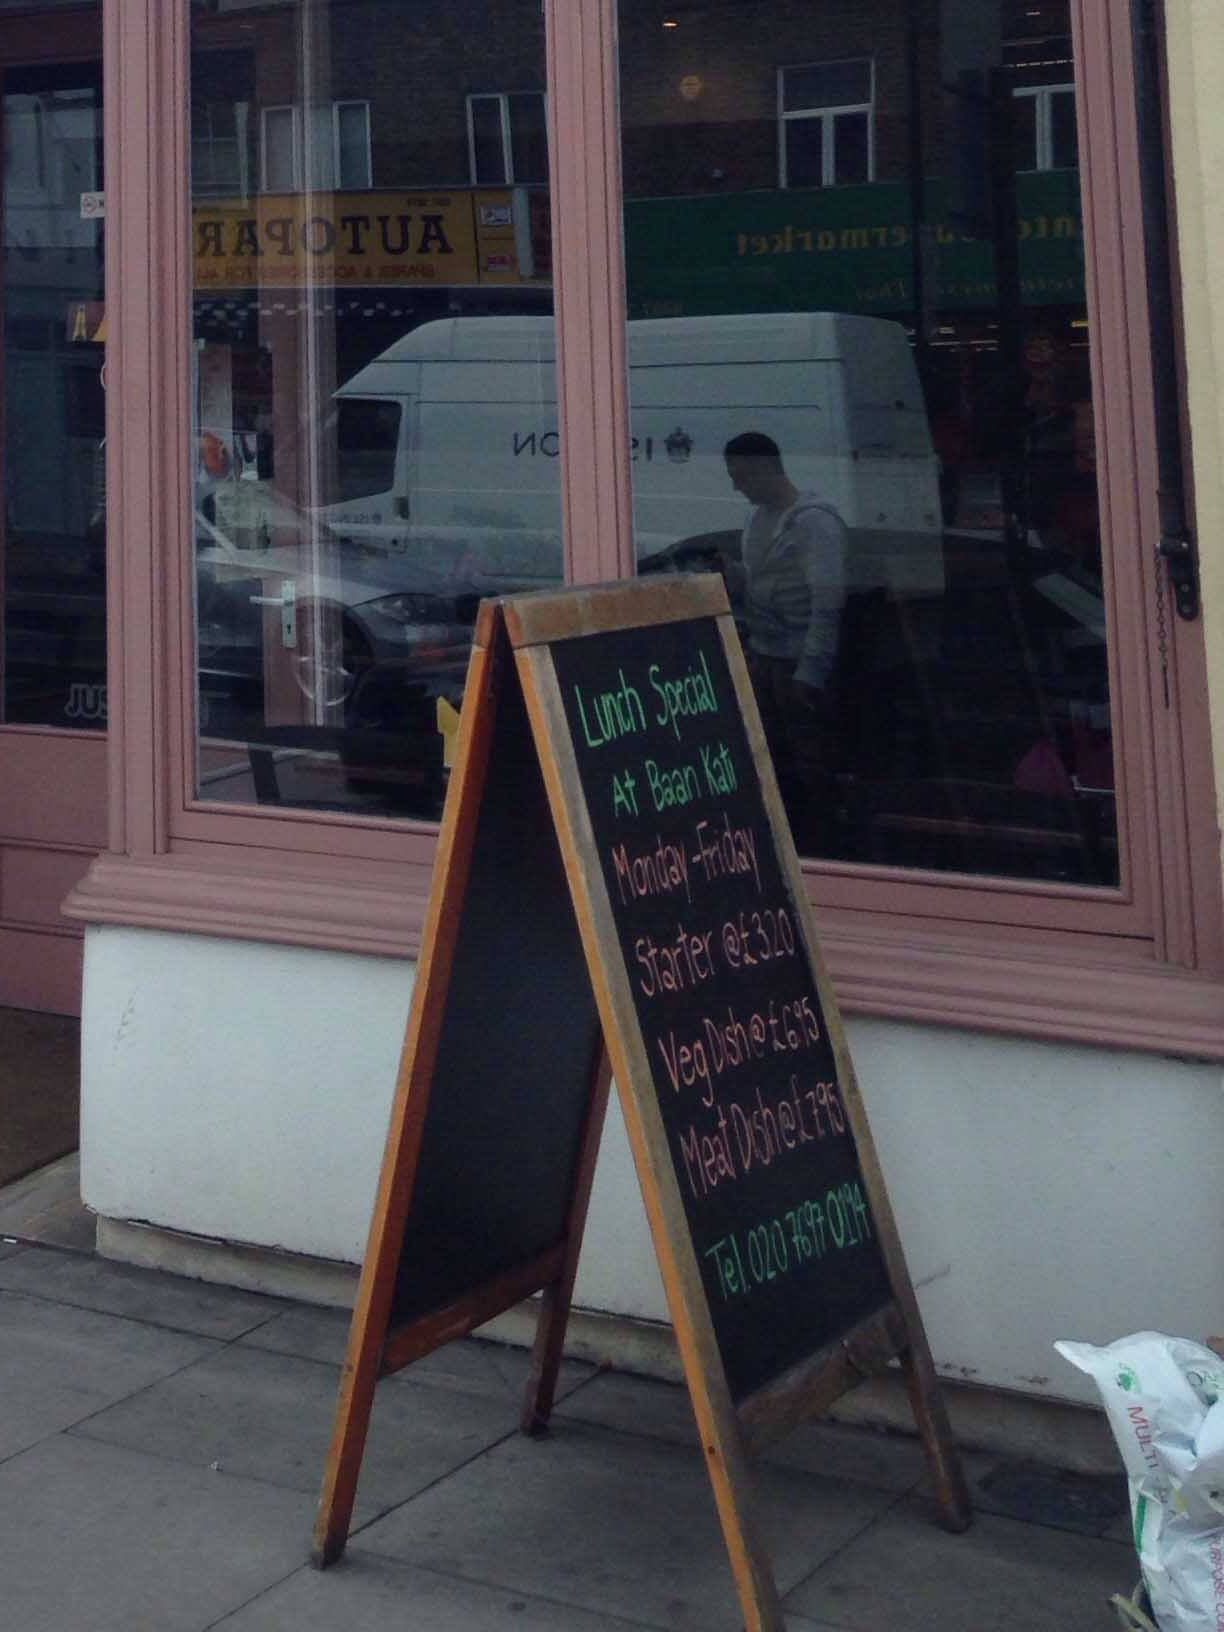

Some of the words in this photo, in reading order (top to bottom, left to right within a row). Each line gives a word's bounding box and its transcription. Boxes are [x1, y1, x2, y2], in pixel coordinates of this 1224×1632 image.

[574, 669, 647, 747] Lunch
[649, 649, 718, 741] Special
[613, 770, 639, 816] At
[645, 760, 701, 812] Baan
[699, 743, 738, 796] Kati
[635, 922, 716, 997] Starter
